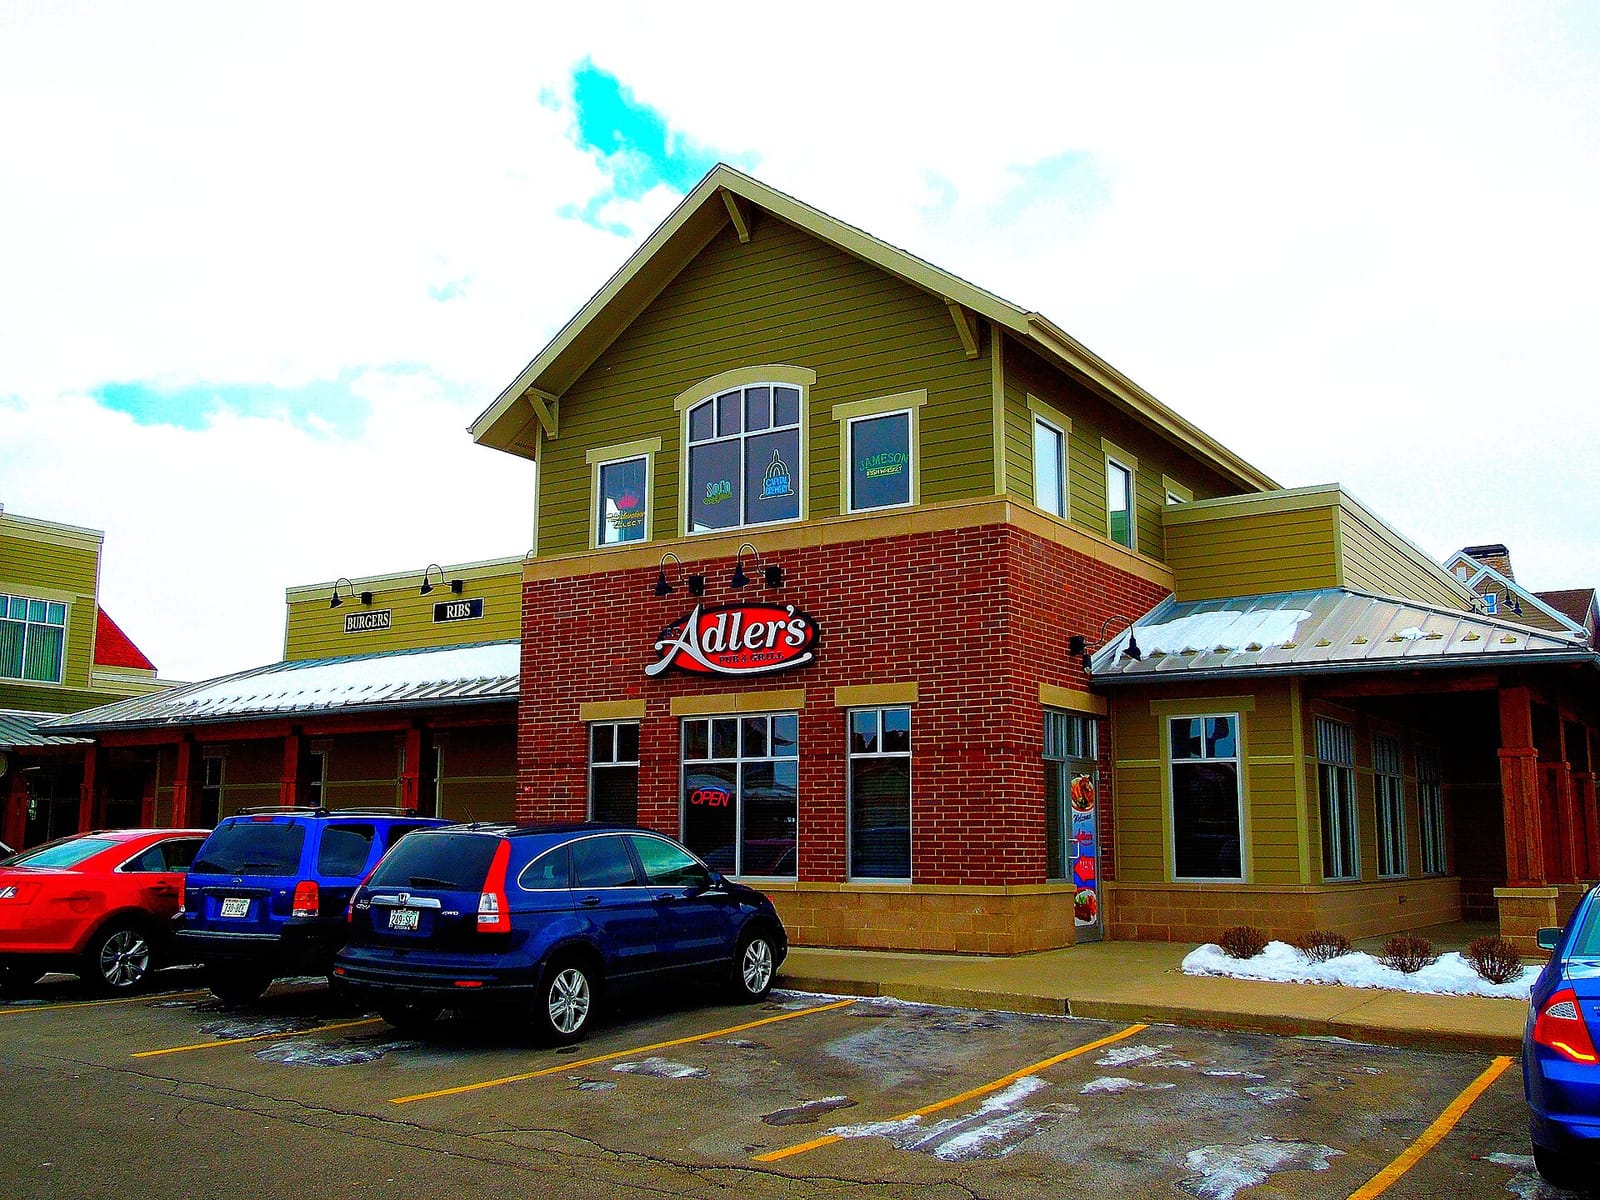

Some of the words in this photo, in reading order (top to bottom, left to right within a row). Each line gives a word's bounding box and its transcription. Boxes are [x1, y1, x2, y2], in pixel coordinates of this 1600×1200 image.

[859, 452, 909, 471] JAMESON
[446, 602, 471, 619] RIBS
[346, 612, 389, 630] BURGERS
[645, 603, 813, 676] Adler's
[719, 654, 739, 663] PUB
[750, 651, 784, 662] GRILL
[691, 790, 730, 807] OPEN
